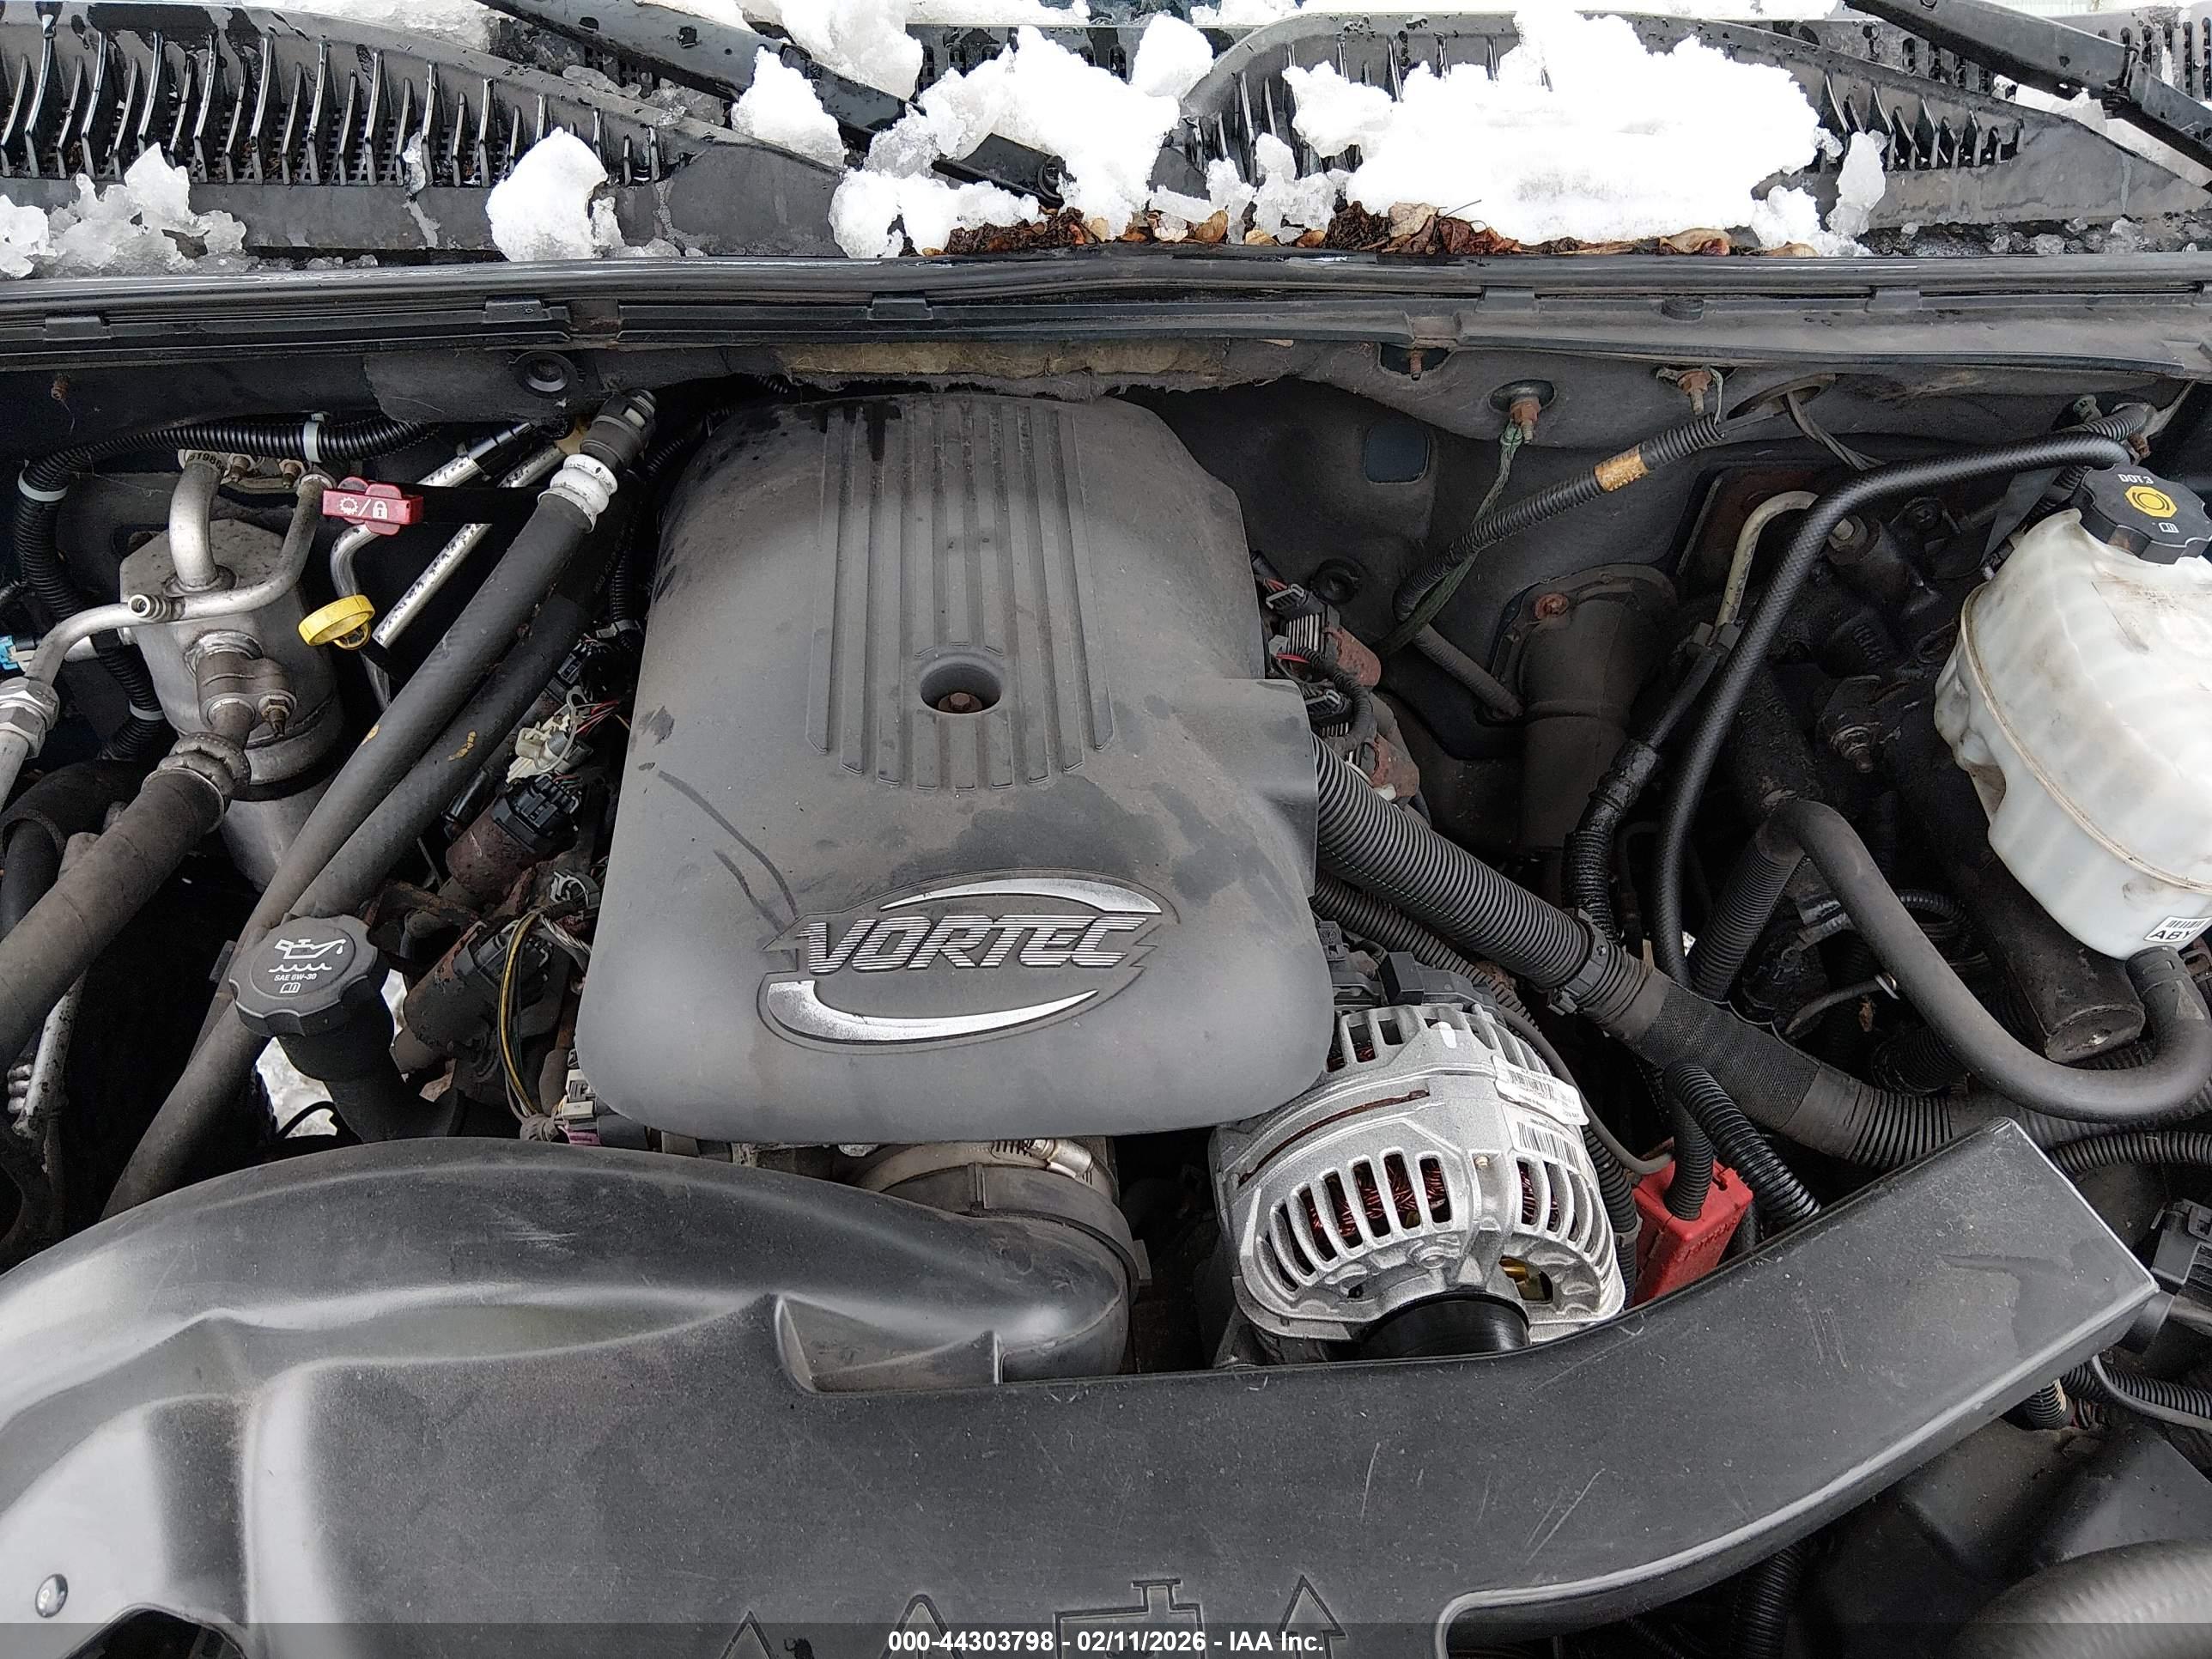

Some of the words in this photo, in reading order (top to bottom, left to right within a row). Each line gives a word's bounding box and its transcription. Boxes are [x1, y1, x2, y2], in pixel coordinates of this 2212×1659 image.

[2118, 473, 2144, 483] DOT
[2142, 476, 2154, 484] 3
[2149, 930, 2197, 940] ABY
[797, 915, 1148, 974] VORTEC
[274, 973, 291, 981] SAE
